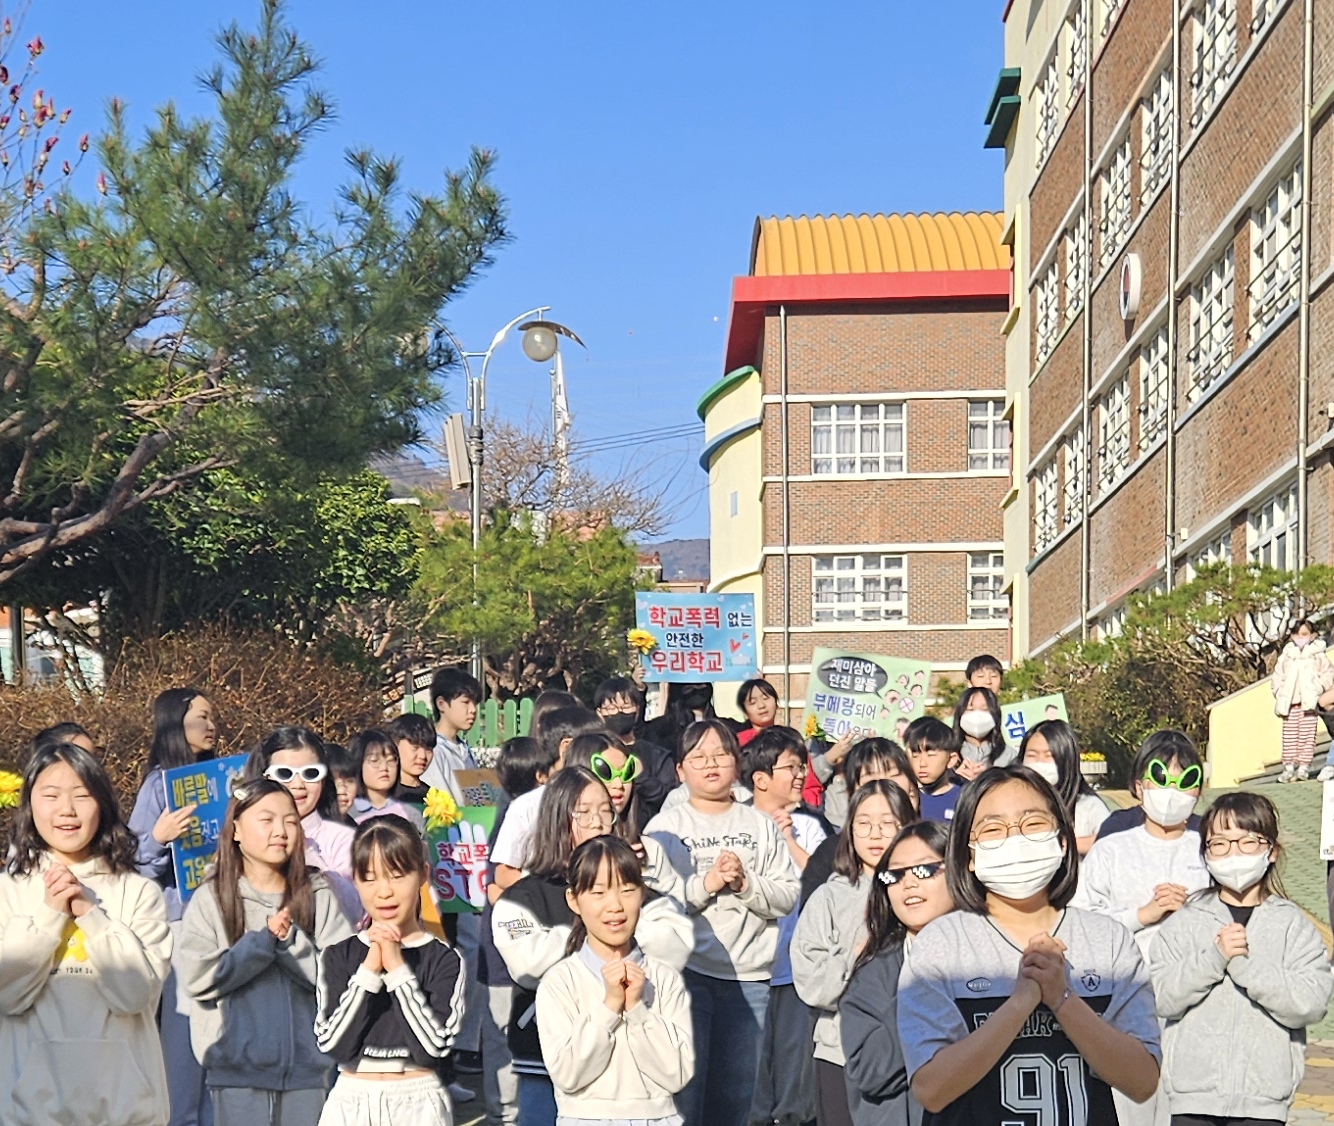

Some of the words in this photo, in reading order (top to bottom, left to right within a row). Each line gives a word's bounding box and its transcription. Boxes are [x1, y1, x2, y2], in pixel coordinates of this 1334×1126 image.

[649, 606, 720, 628] 학교폭력
[727, 611, 752, 628] 없는
[666, 632, 704, 648] 안전한
[652, 651, 723, 673] 우리학교
[829, 659, 877, 677] 재미삼아
[829, 673, 851, 689] 던진
[813, 693, 877, 720] 부메랑되어
[437, 843, 488, 867] 학교폭
